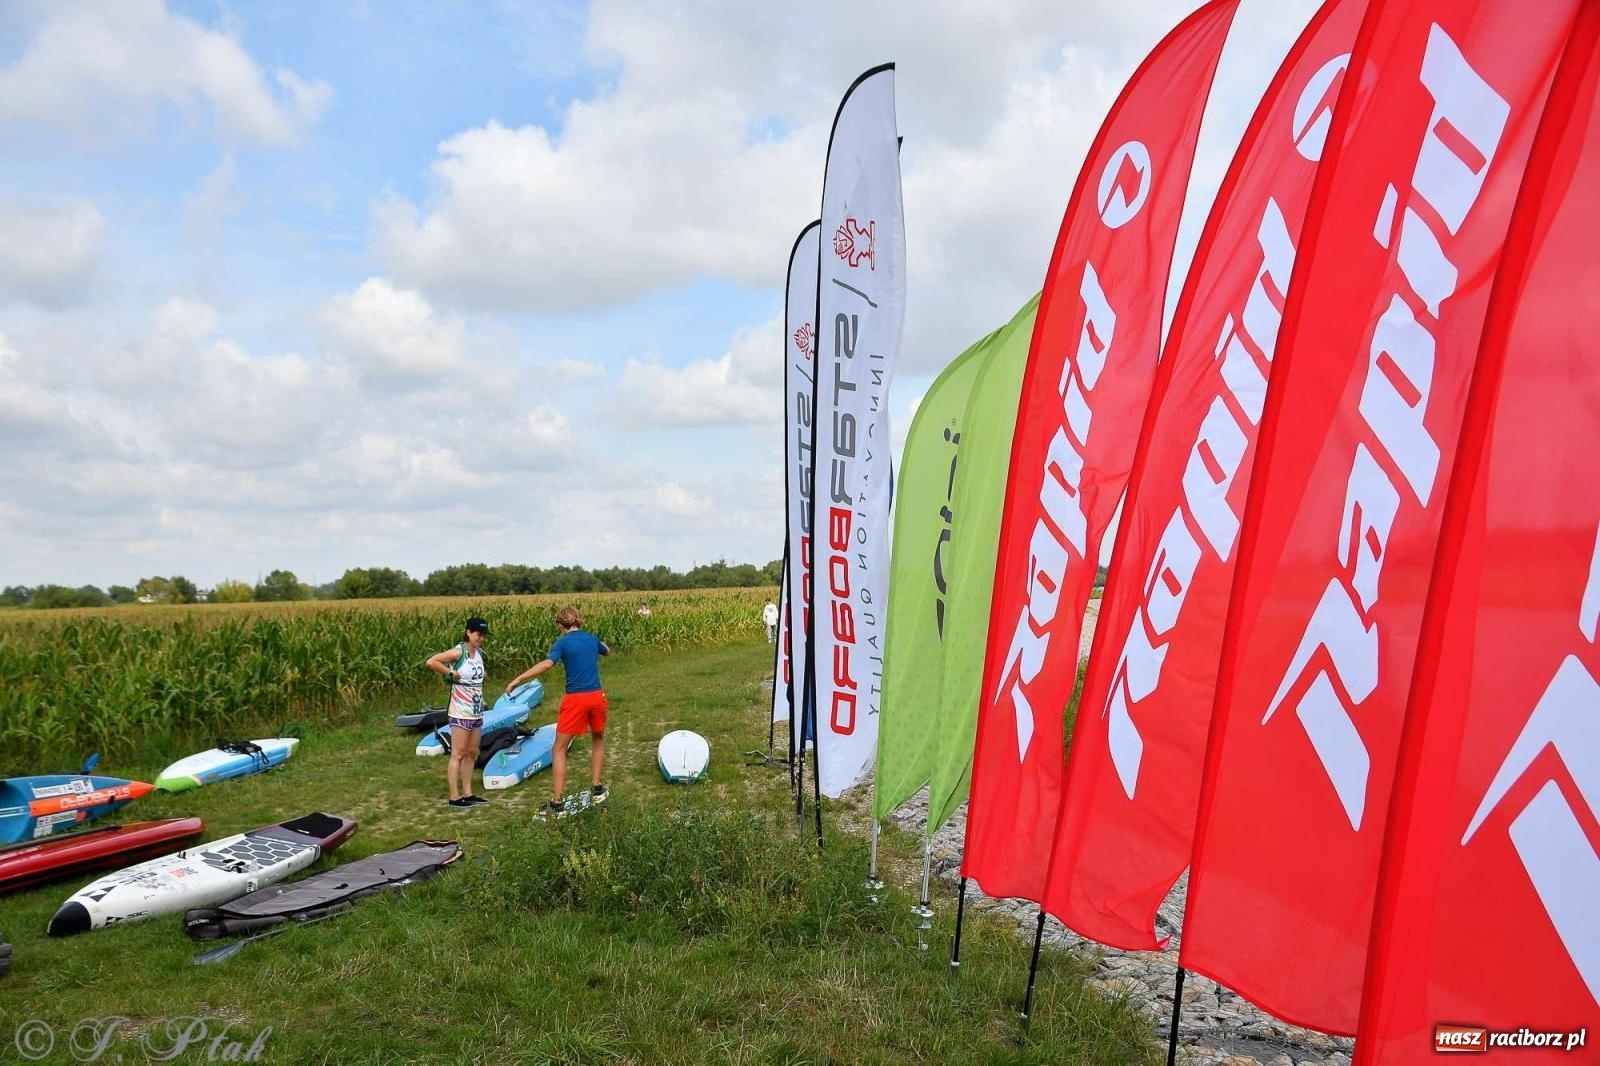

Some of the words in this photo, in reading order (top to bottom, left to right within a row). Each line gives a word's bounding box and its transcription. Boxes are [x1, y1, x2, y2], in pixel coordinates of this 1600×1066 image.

[471, 666, 483, 681] 22
[993, 258, 1117, 765] Rapid
[1260, 20, 1511, 832] Rapid
